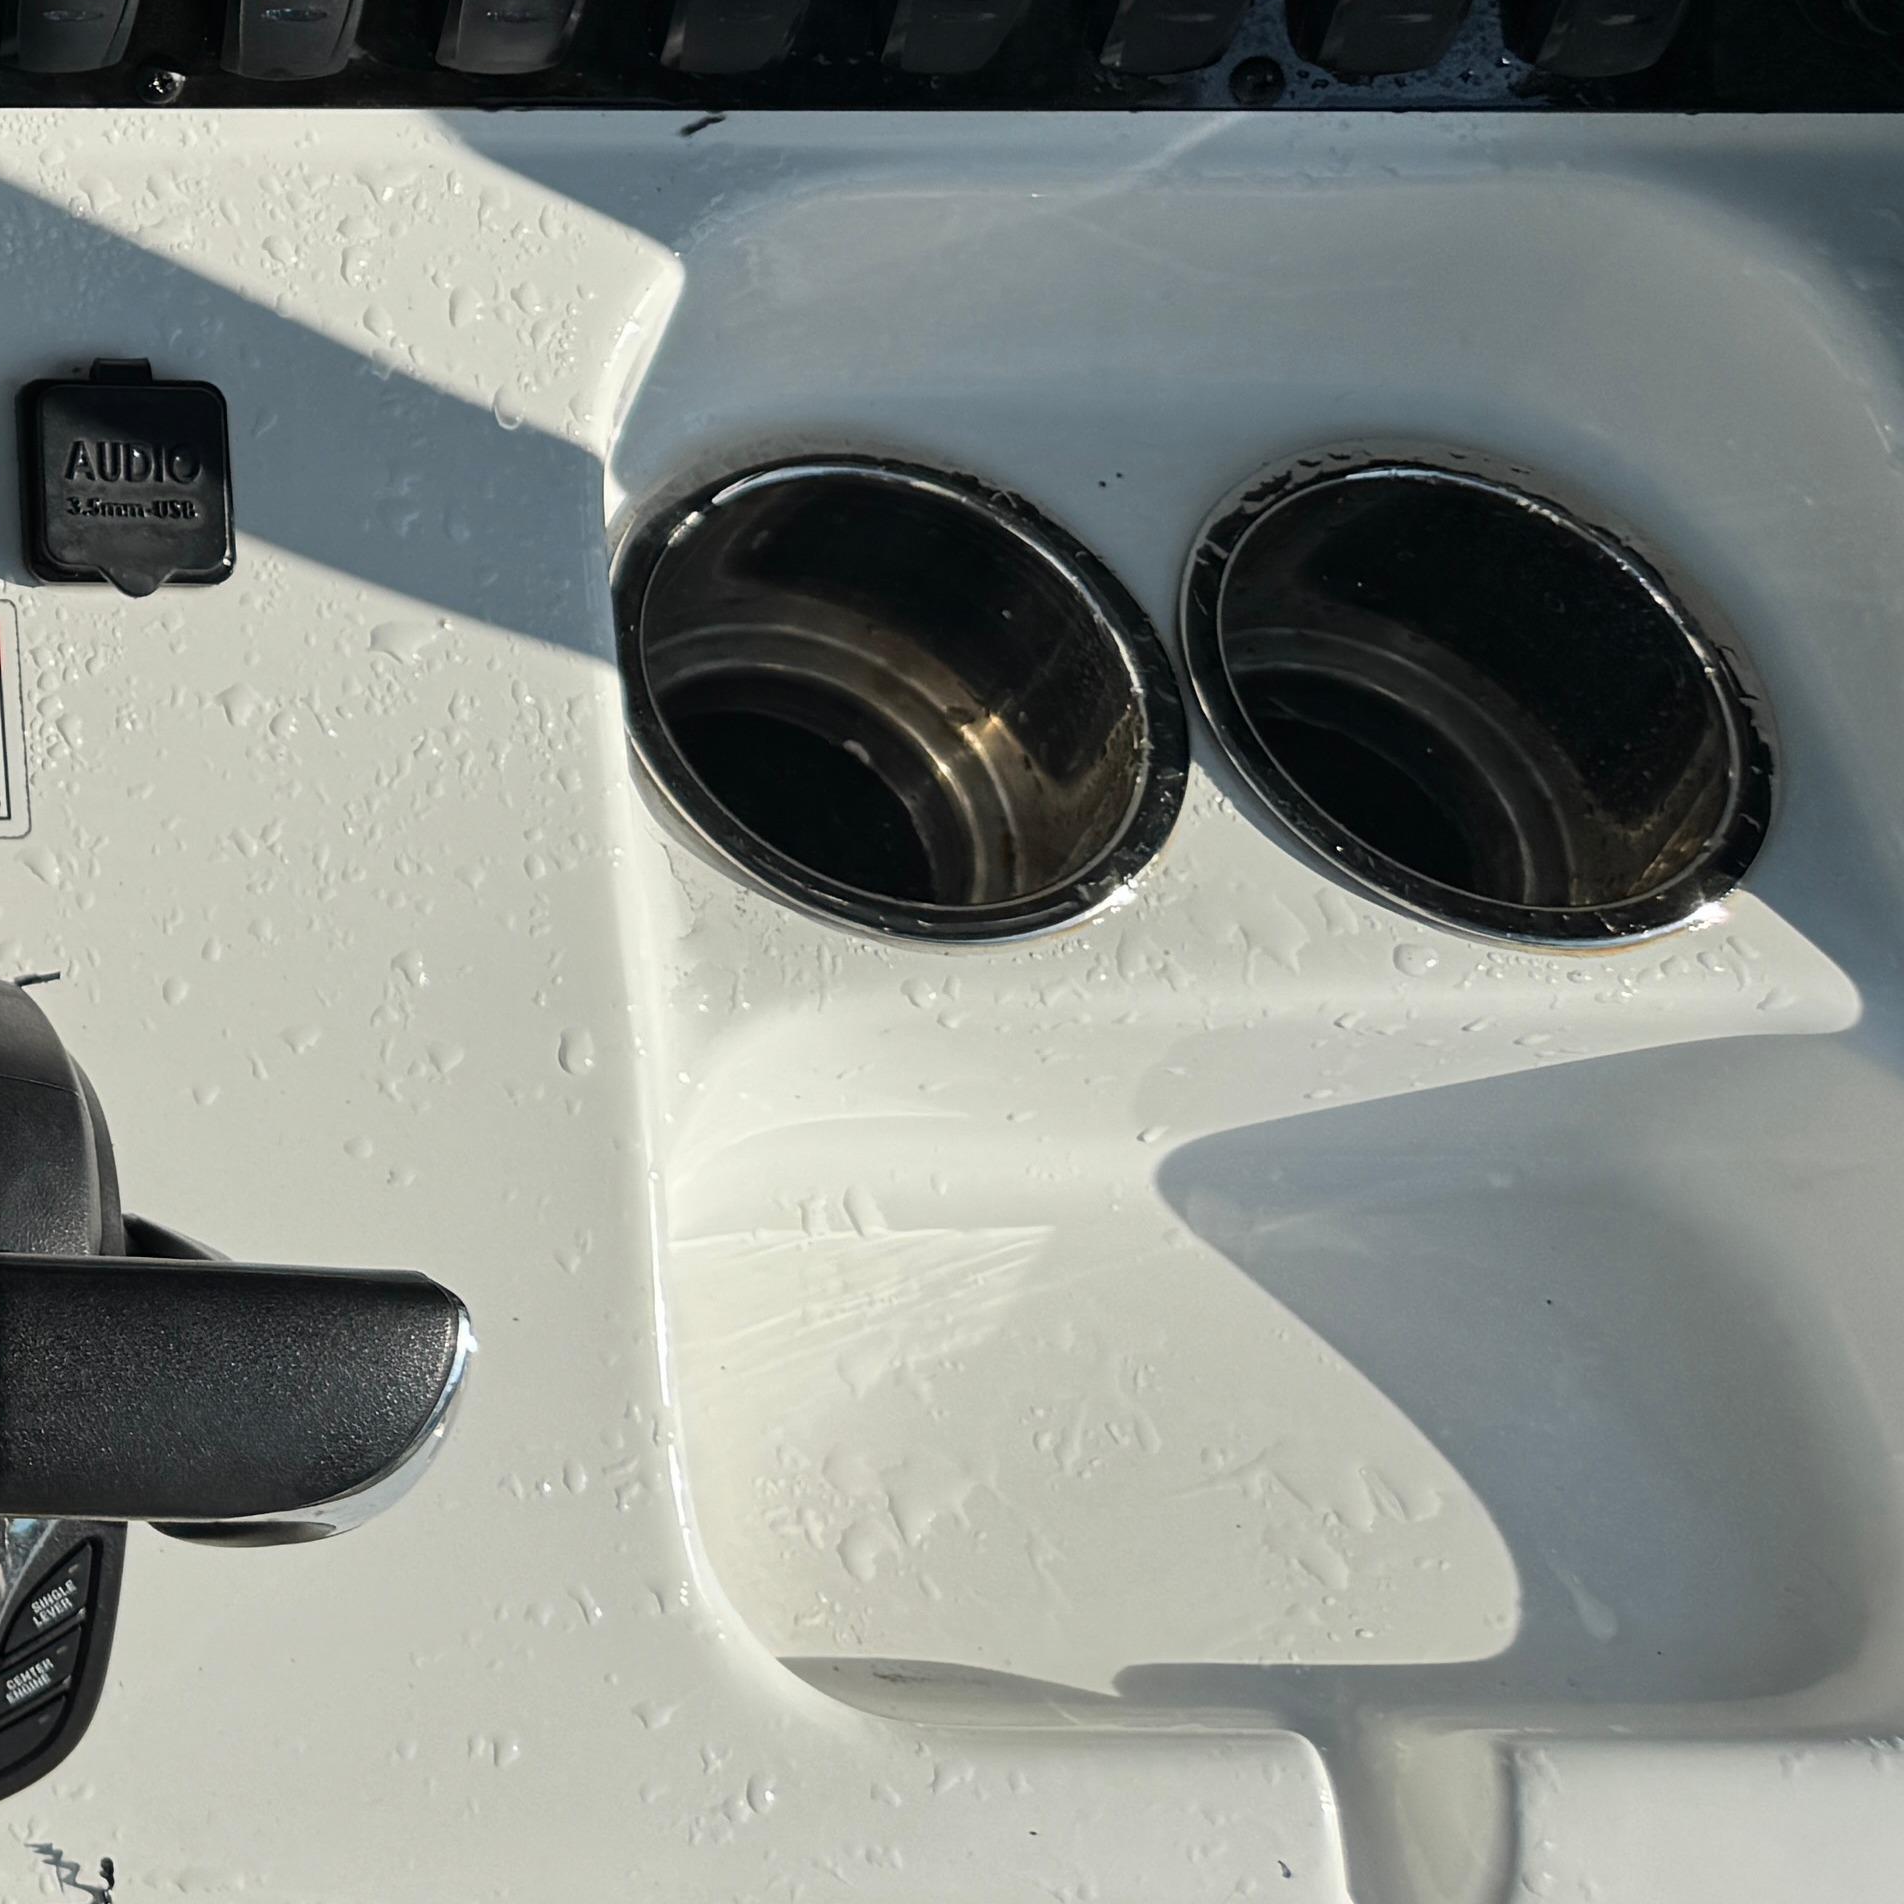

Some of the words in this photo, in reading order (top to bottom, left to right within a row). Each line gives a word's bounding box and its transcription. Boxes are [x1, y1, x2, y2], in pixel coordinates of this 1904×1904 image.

[64, 440, 202, 484] AUDIO
[31, 1579, 77, 1614] SINGLE
[33, 1597, 73, 1627] LEVER
[6, 1658, 54, 1691] CENTER
[6, 1673, 51, 1704] ENGINE
